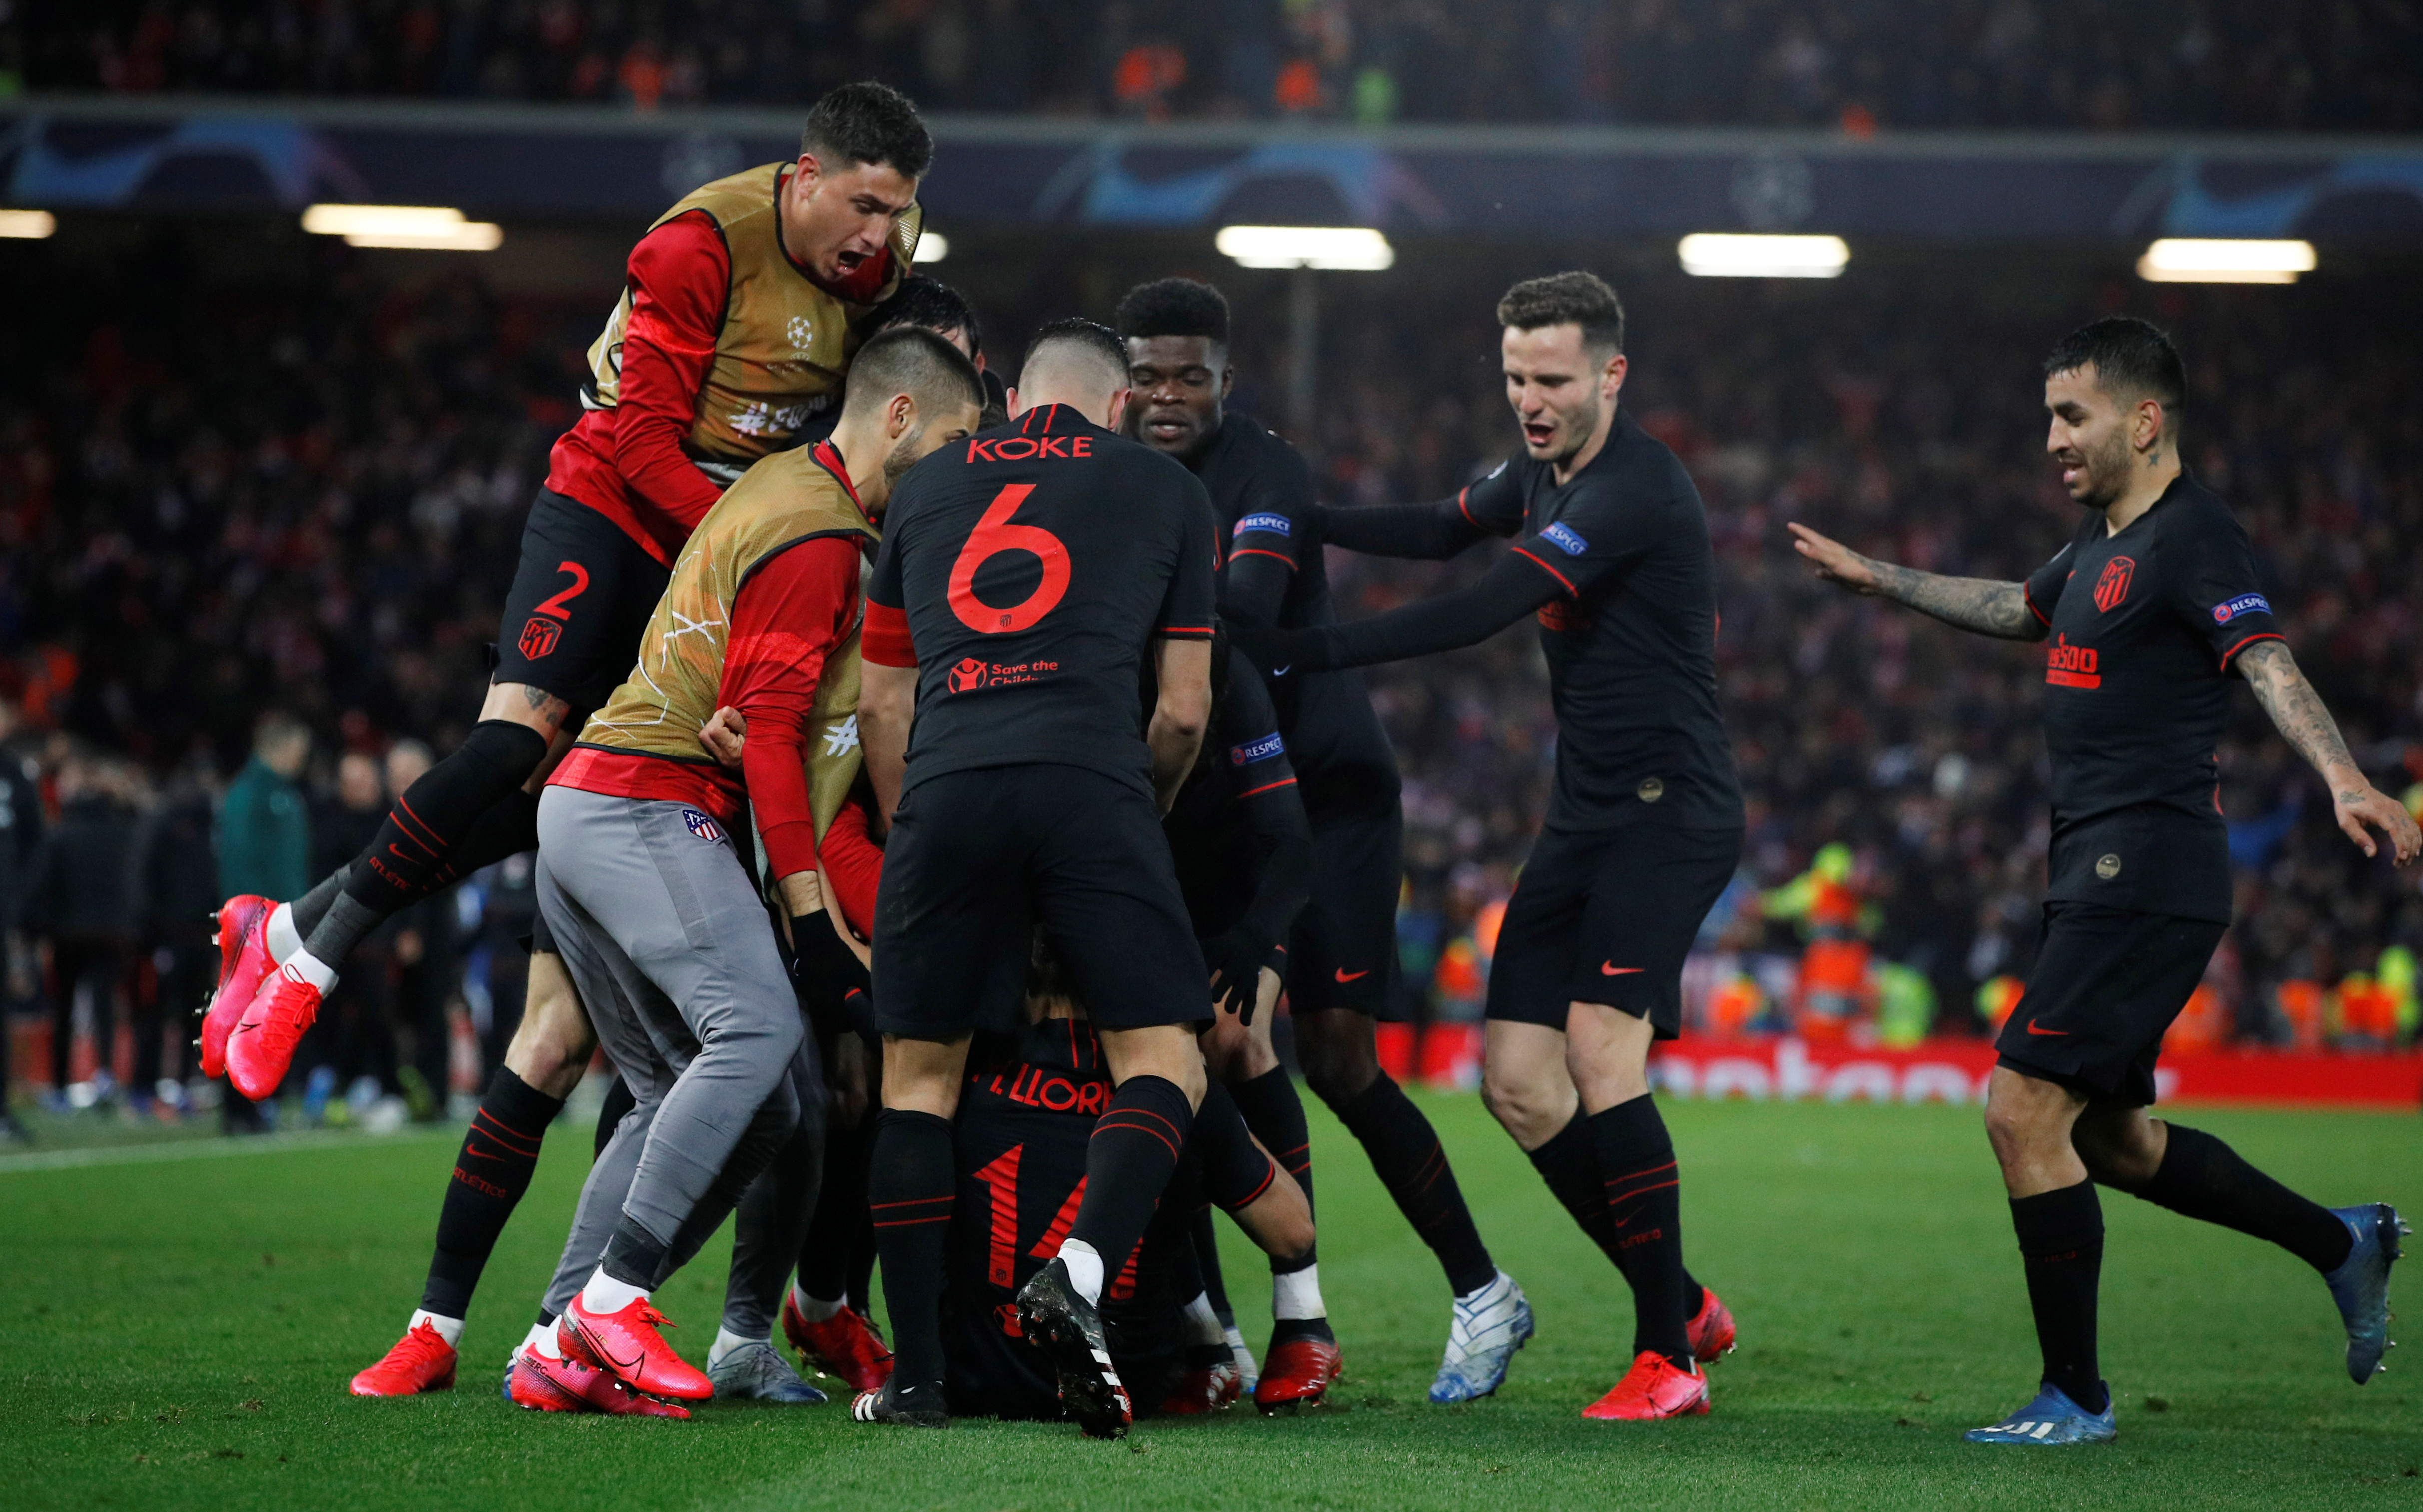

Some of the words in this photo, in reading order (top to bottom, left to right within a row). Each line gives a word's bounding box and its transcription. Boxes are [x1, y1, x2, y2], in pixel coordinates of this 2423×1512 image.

[966, 436, 1093, 464] KOKE
[1245, 516, 1289, 531] RESPECT
[947, 483, 1072, 634] 6
[533, 561, 589, 621] 2
[992, 664, 1028, 675] Save
[1032, 660, 1058, 671] the
